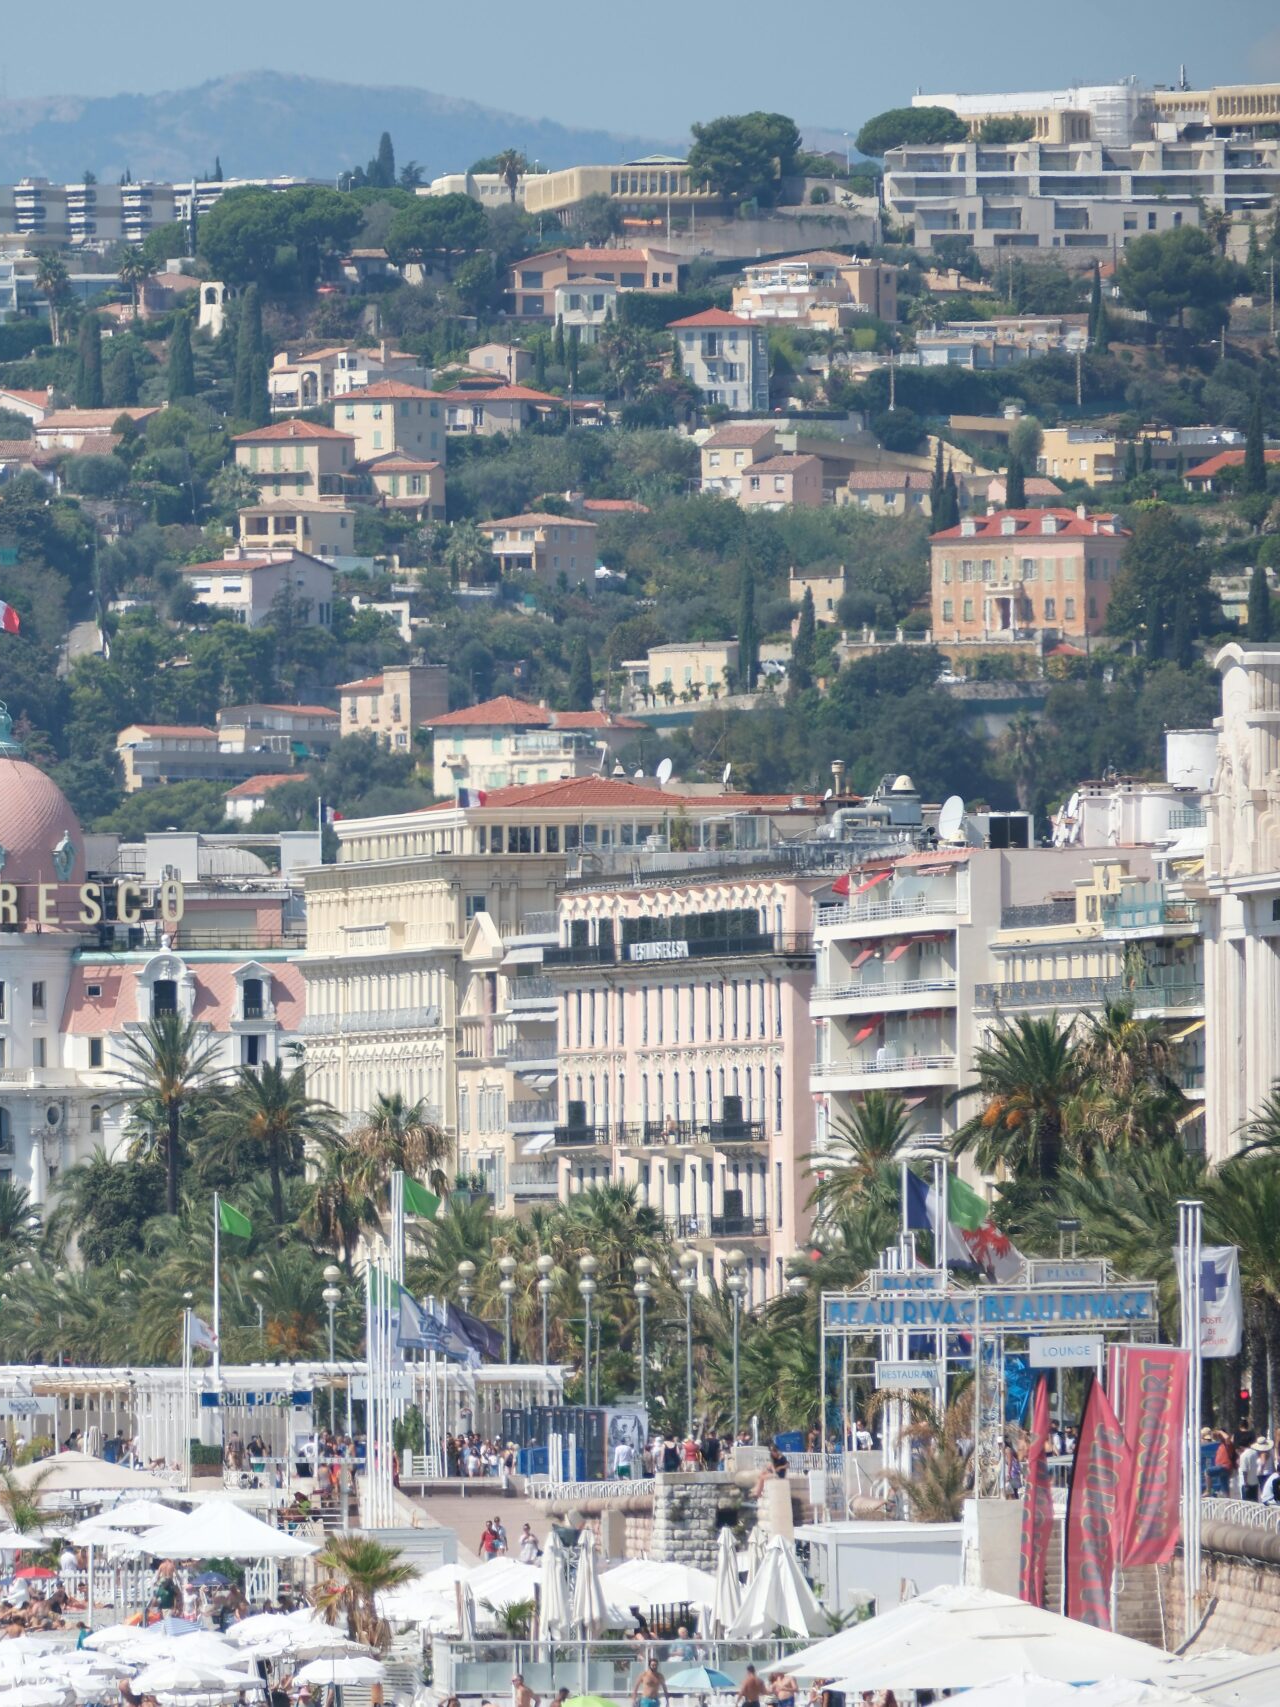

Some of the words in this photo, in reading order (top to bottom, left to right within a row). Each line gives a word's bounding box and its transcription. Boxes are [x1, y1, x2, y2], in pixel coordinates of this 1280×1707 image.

[1047, 1268, 1087, 1278] PLAGE
[830, 1301, 895, 1325] BEAU
[903, 1300, 976, 1325] RIVAG
[984, 1294, 1054, 1322] BEAU
[1061, 1291, 1150, 1320] RIVAGE
[1041, 1345, 1091, 1357] LOUNGE
[881, 1369, 937, 1379] RESTAURANT
[218, 1392, 250, 1406] RUHL
[255, 1391, 294, 1406] PLAGE
[1136, 1358, 1176, 1544] WATERSPORT
